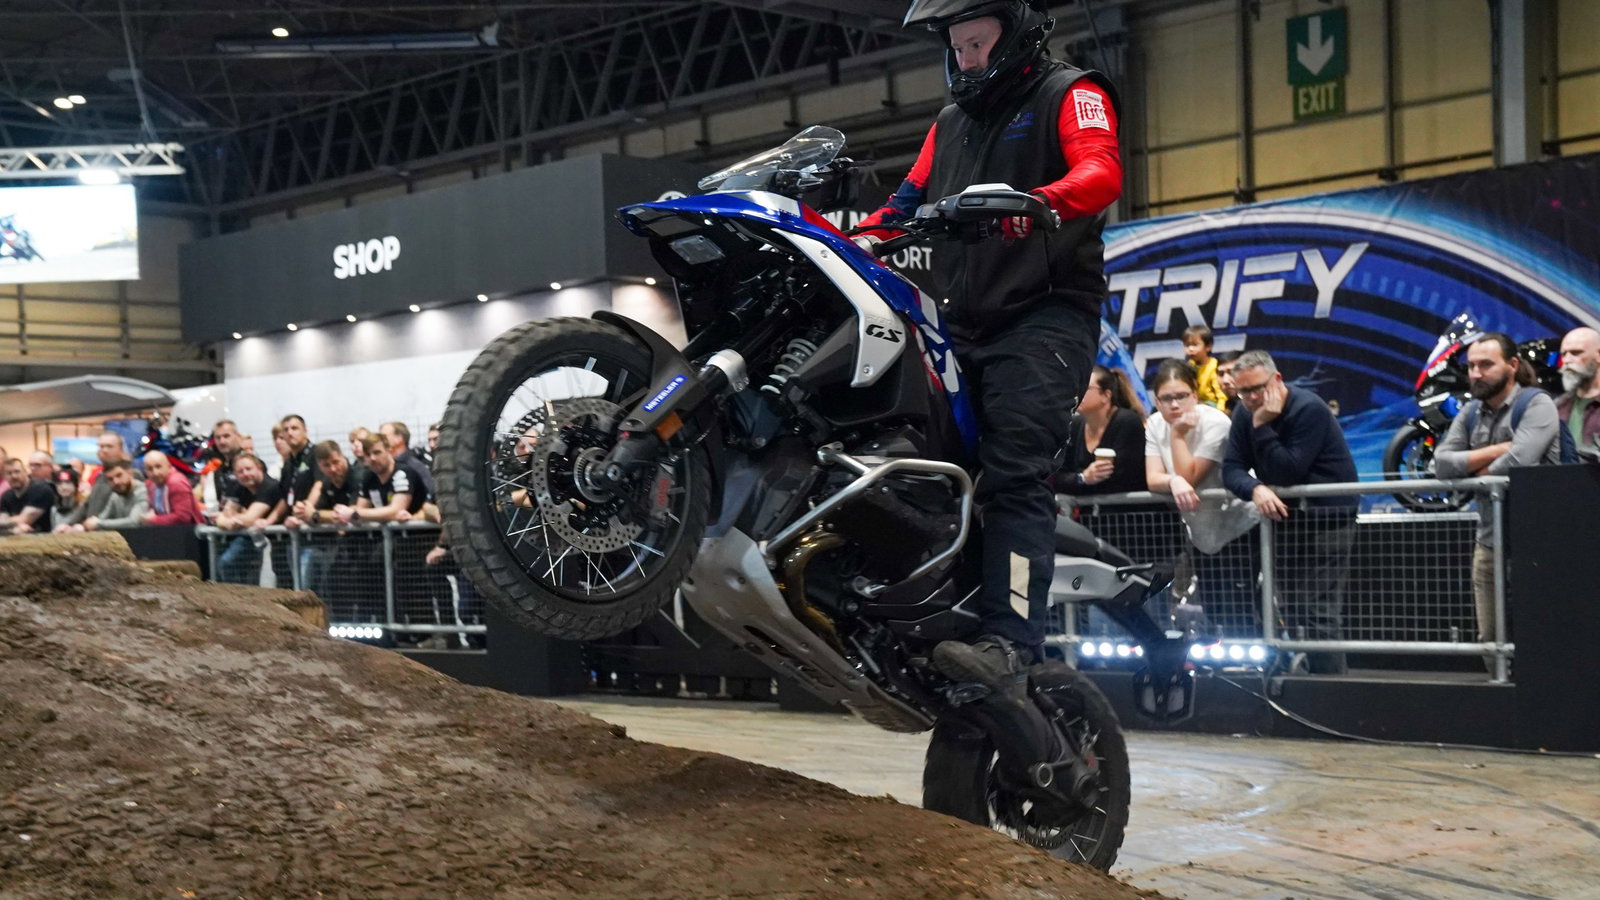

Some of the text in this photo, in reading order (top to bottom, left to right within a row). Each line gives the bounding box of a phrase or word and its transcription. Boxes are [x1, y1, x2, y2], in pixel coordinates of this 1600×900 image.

[1299, 82, 1337, 115] EXIT
[333, 235, 401, 279] SHOP
[882, 246, 933, 270] ORT
[1104, 242, 1370, 338] TRIFY
[865, 324, 902, 343] GS
